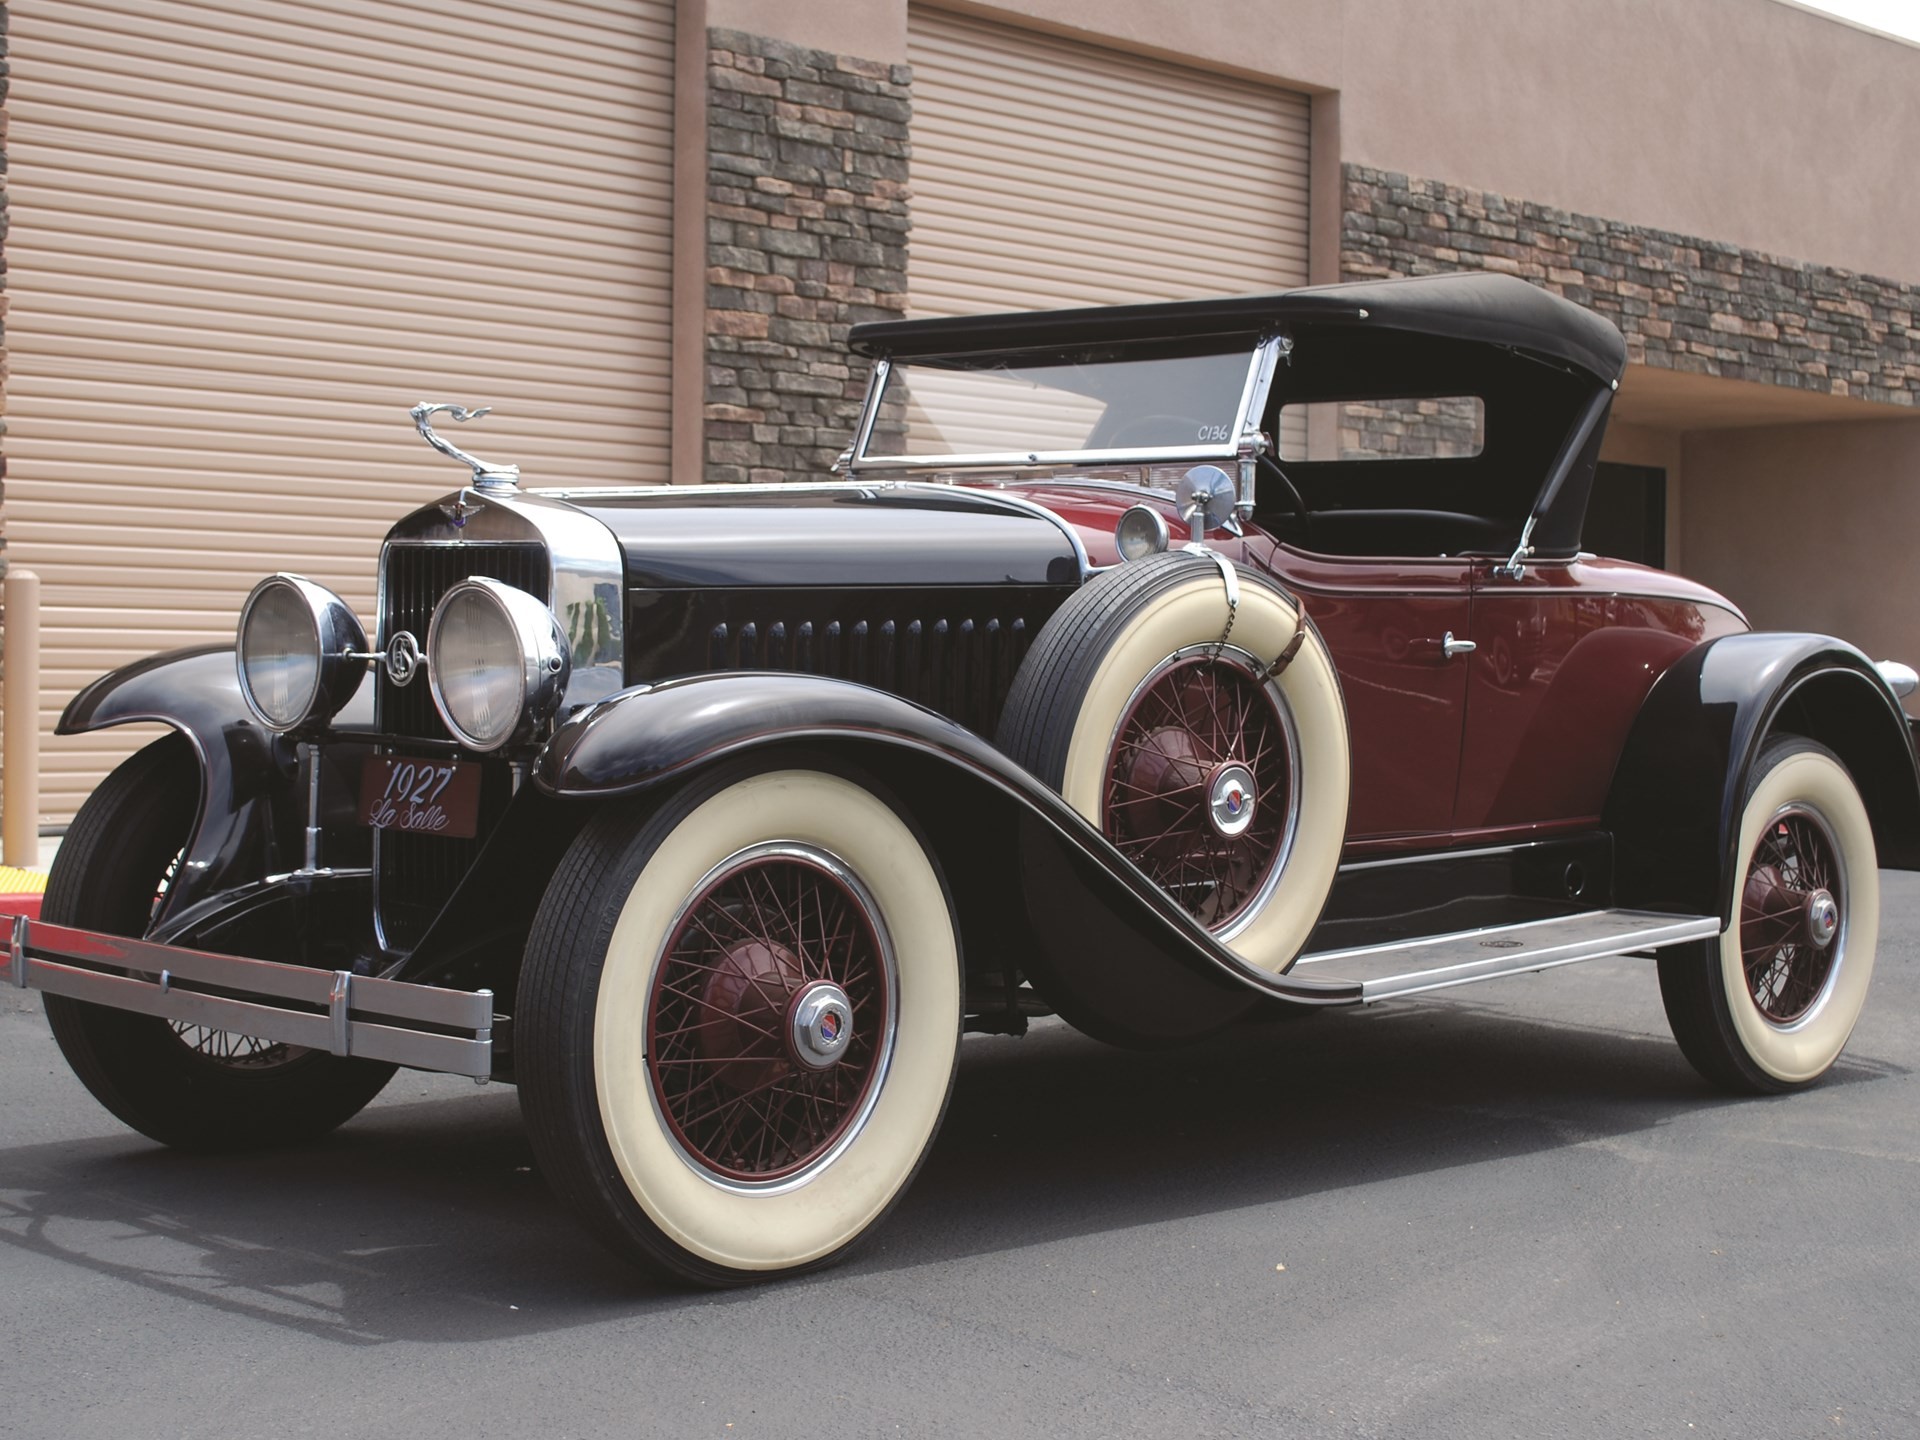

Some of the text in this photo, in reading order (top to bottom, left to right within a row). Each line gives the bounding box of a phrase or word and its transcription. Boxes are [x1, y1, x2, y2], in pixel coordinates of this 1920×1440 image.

[1198, 424, 1228, 441] C136
[384, 762, 452, 803] 1927
[368, 798, 450, 831] La Salle
